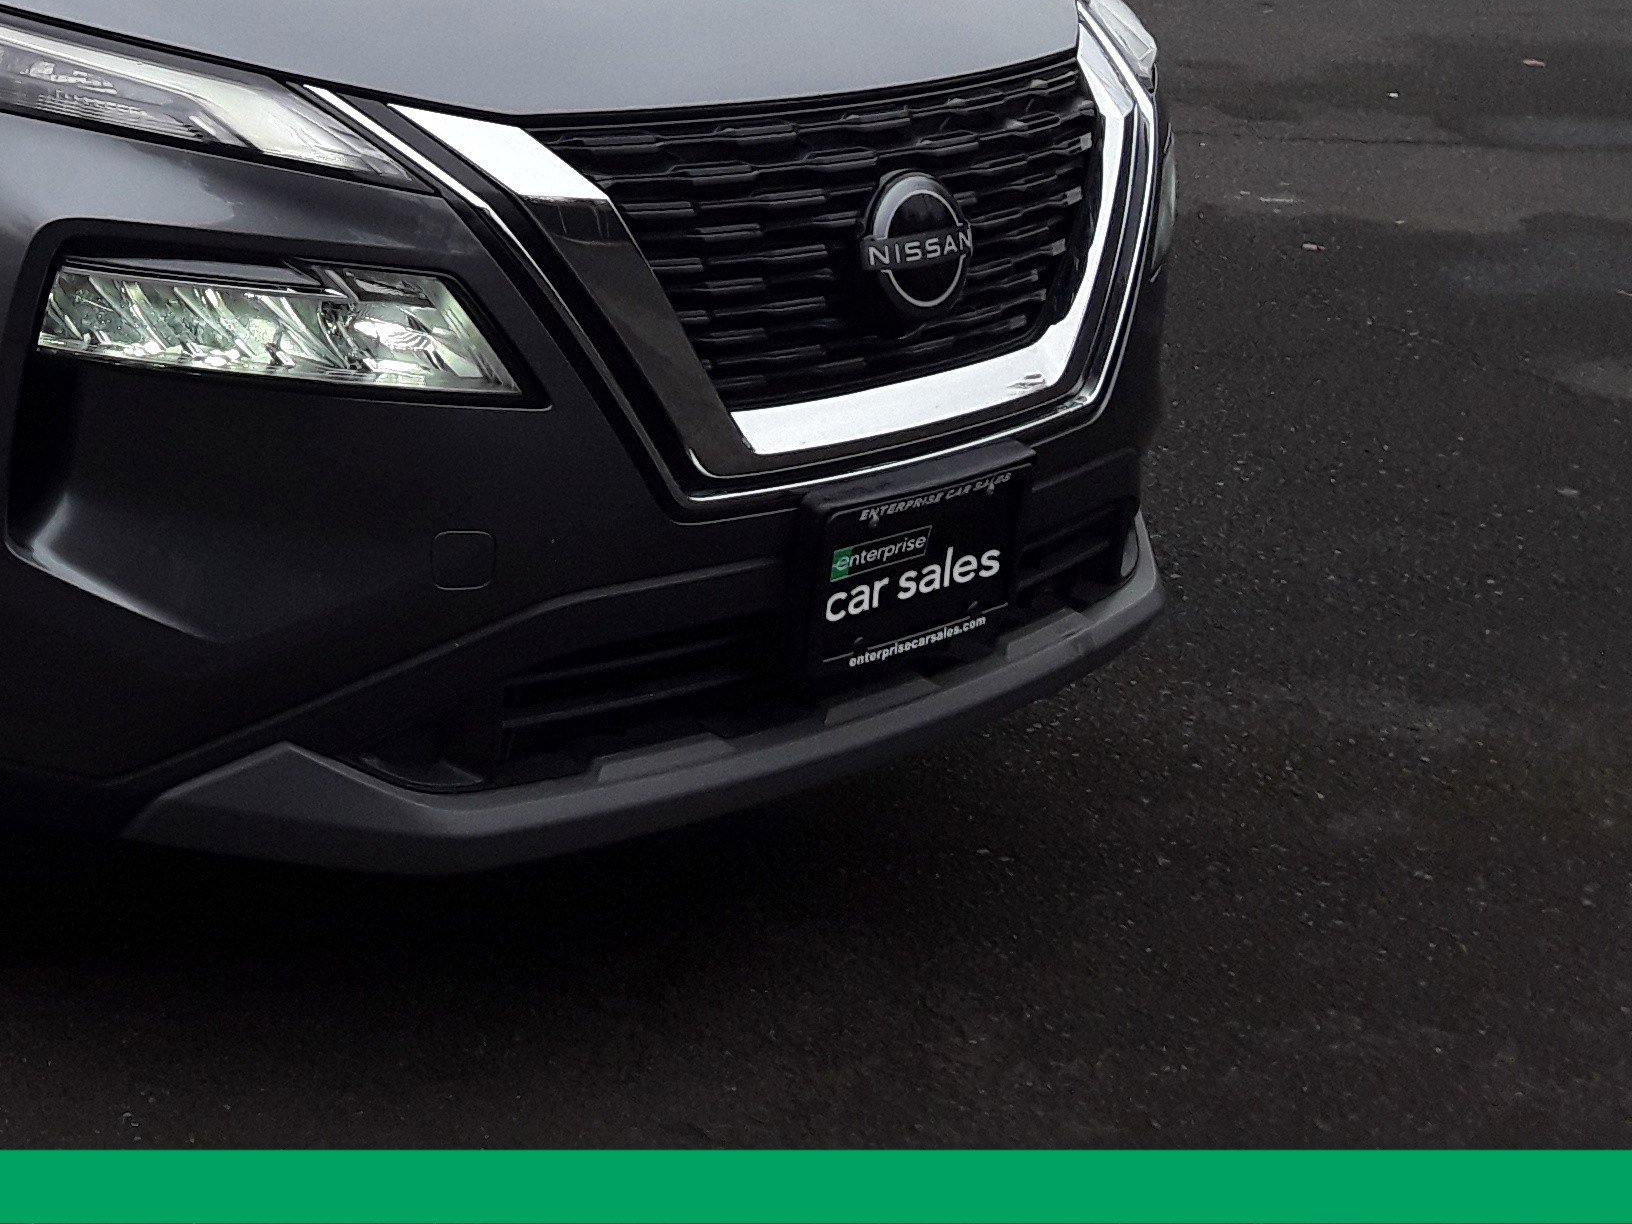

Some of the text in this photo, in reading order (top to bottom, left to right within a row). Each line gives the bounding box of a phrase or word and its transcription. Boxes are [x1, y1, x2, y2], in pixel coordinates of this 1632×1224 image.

[868, 231, 972, 266] NISSAN
[859, 492, 944, 521] ENTERPRISE
[945, 485, 972, 500] CAR
[833, 535, 927, 571] enterprise
[825, 546, 1001, 622] car sales
[849, 616, 986, 667] enterprisecarsales.com
